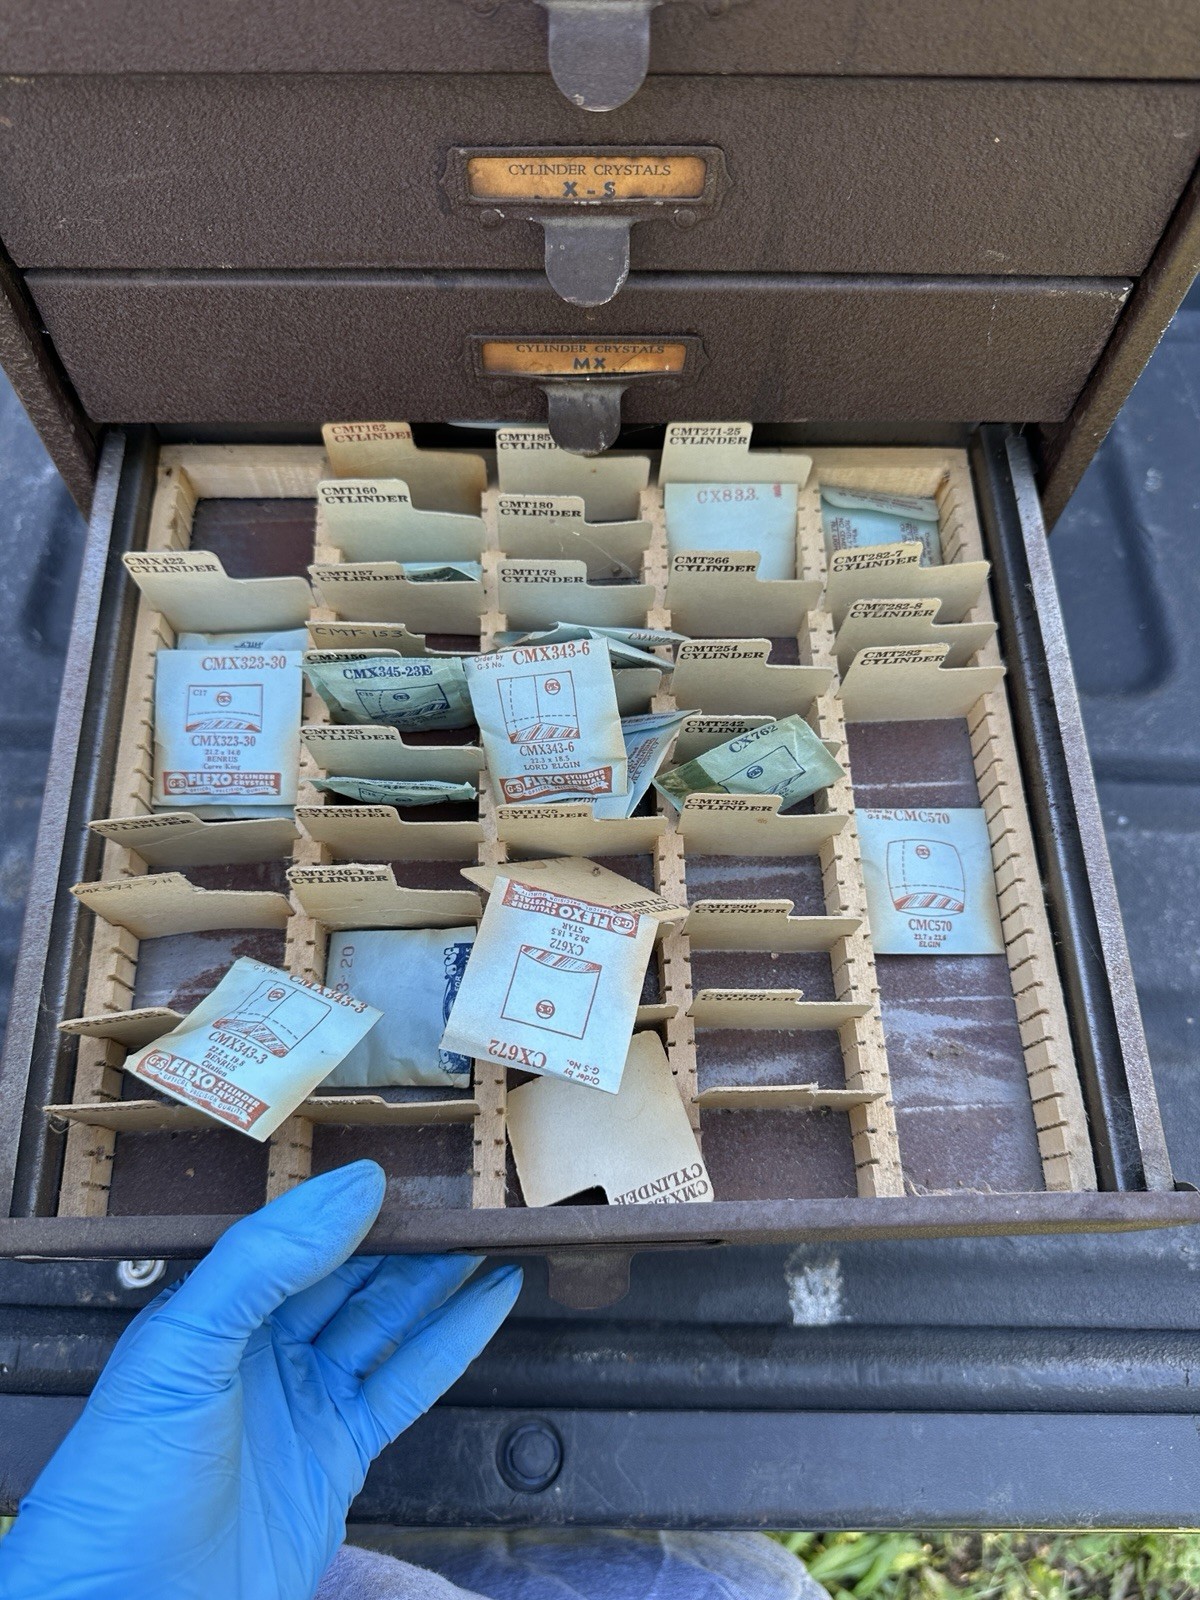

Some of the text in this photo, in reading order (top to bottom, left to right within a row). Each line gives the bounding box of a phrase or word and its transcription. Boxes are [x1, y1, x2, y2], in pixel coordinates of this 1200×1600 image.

[508, 164, 671, 176] CYLINDER CRYSTALS
[562, 181, 577, 197] X
[603, 181, 616, 198] S
[516, 344, 665, 354] CYLINDER CRYSTALS
[331, 423, 387, 435] CMT162
[669, 427, 741, 436] CMT271-25
[500, 442, 558, 450] CYLIND
[669, 435, 748, 445] CYLINDER
[321, 486, 377, 496] CMT160
[325, 495, 409, 504] CYLINDER
[498, 500, 554, 509] CMT180
[500, 508, 582, 518] CYLINDER
[124, 557, 185, 566] CMX422
[674, 556, 730, 565] CMT266
[834, 549, 904, 564] CMT282-7
[130, 564, 218, 573] CYLINDER
[674, 564, 756, 573] CYLINDER
[833, 555, 918, 572] CYLINDER
[320, 574, 406, 582] CYLINDER
[501, 568, 557, 576] CMT178
[502, 576, 584, 584] CYLINDER
[852, 602, 923, 611] CMT282-8
[850, 609, 935, 618] CYLINDER
[474, 653, 504, 663] Order by
[512, 641, 590, 666] CMX343-6
[680, 651, 765, 660] CYLINDER
[863, 649, 922, 659] CMT282
[202, 656, 287, 671] CMX323-30
[860, 655, 945, 666] CYLINDER
[343, 664, 433, 681] CMX345-23E
[191, 735, 256, 747] CMX323-30
[728, 724, 778, 753] CX762
[519, 741, 575, 757] CMX343-6
[552, 761, 580, 770] ELGIN
[187, 773, 232, 785] FLEXO
[565, 769, 605, 780] CYLINDER
[567, 775, 606, 785] CRYSTALS
[524, 775, 566, 788] FLEXO
[684, 804, 773, 812] CYLINDER
[893, 809, 950, 824] CMC570
[96, 819, 194, 832] CYLINDER
[291, 875, 389, 884] CYLINDER
[510, 900, 557, 915] CYLINDER
[512, 894, 558, 909] CRYSTALS
[611, 898, 669, 911] CYLINDE
[558, 906, 611, 929] FLEXO
[562, 922, 585, 933] STAR
[908, 919, 952, 931] CMC570
[549, 938, 584, 956] CX672
[289, 975, 369, 1013] CMX343-3
[208, 1031, 268, 1065] CMX343-3
[488, 1039, 547, 1069] CX672
[204, 1052, 238, 1072] BENRUS
[566, 1059, 582, 1070] No.
[168, 1058, 217, 1089] FLEXO
[201, 1060, 228, 1078] Citation
[564, 1067, 601, 1085] Order by
[212, 1087, 255, 1113] CRYSTALS
[217, 1080, 261, 1108] CYLINDER
[613, 1162, 703, 1205] CYLINDER
